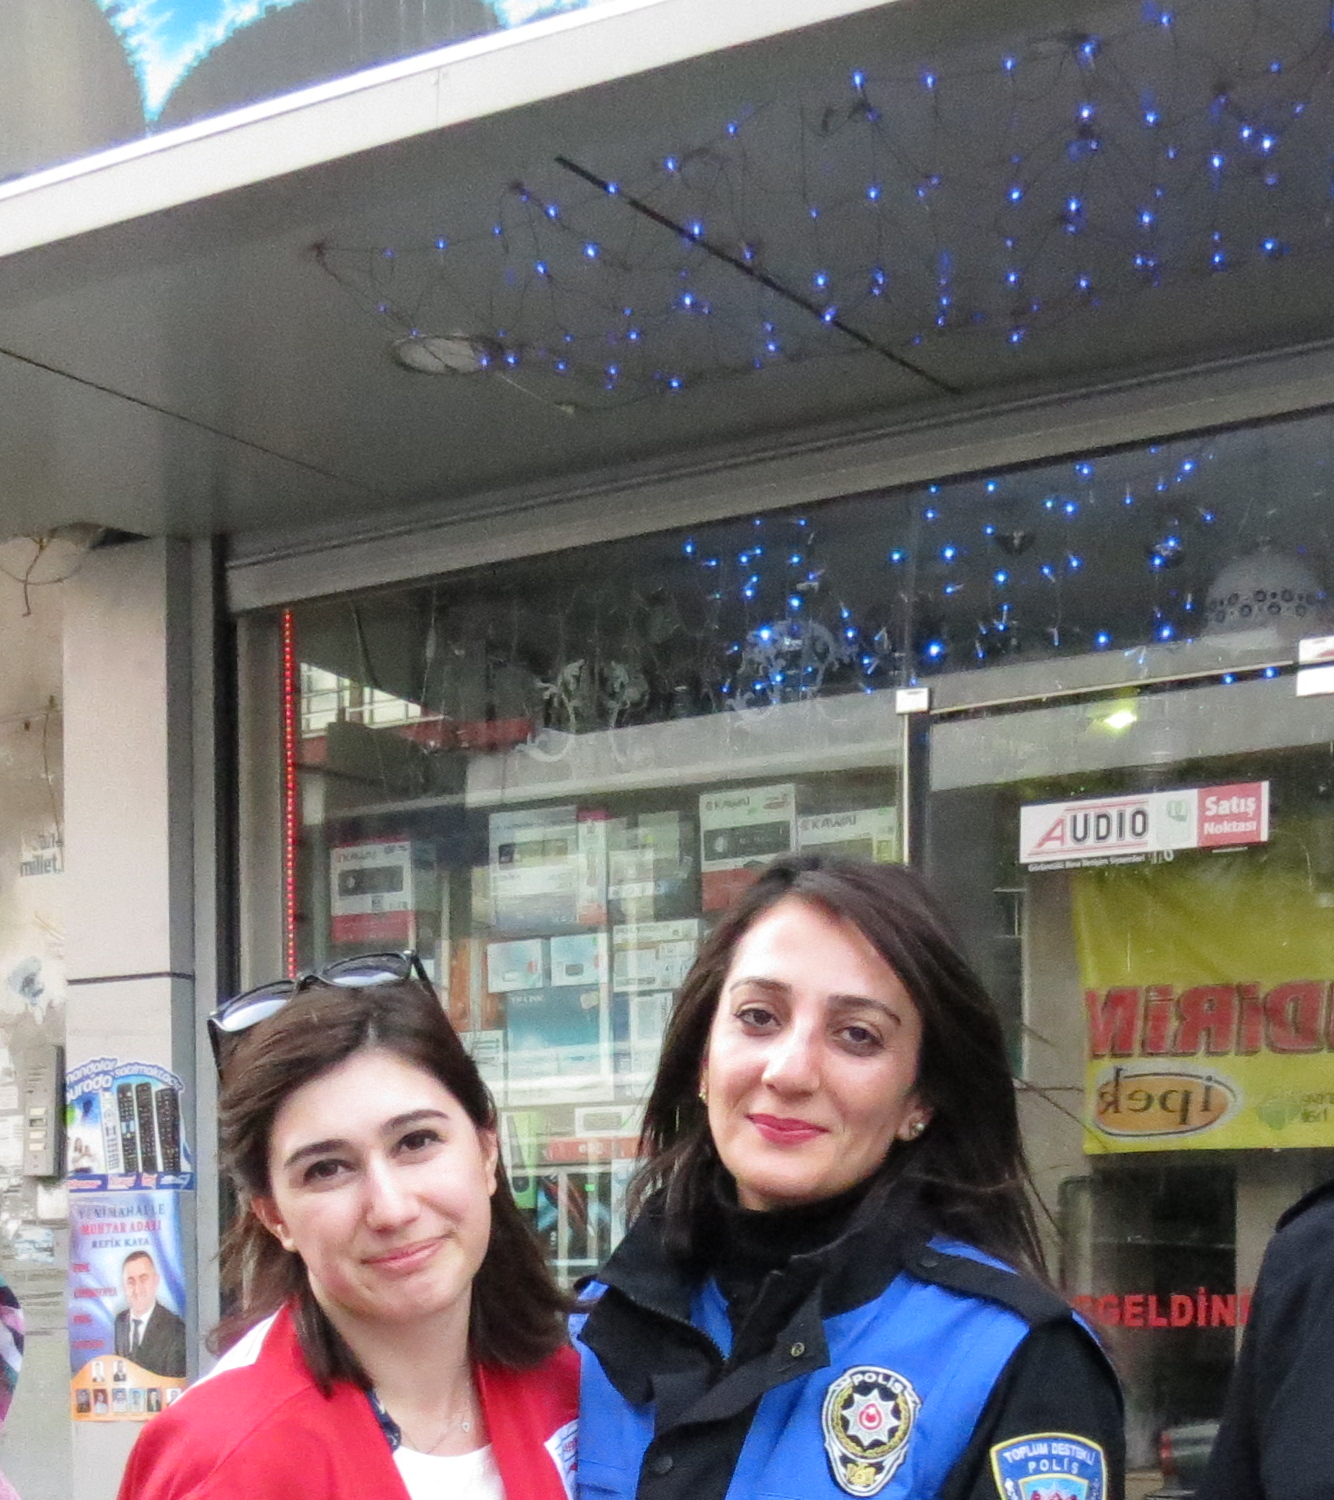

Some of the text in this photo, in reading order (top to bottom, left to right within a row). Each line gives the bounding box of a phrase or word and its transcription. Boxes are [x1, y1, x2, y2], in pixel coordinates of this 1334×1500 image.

[1205, 796, 1257, 817] Satış
[1035, 809, 1149, 850] AUDIO
[1203, 819, 1257, 836] Noktası
[851, 1372, 905, 1396] POLİS
[1003, 1442, 1049, 1463] TOPLUM
[1028, 1458, 1080, 1475] POLİS
